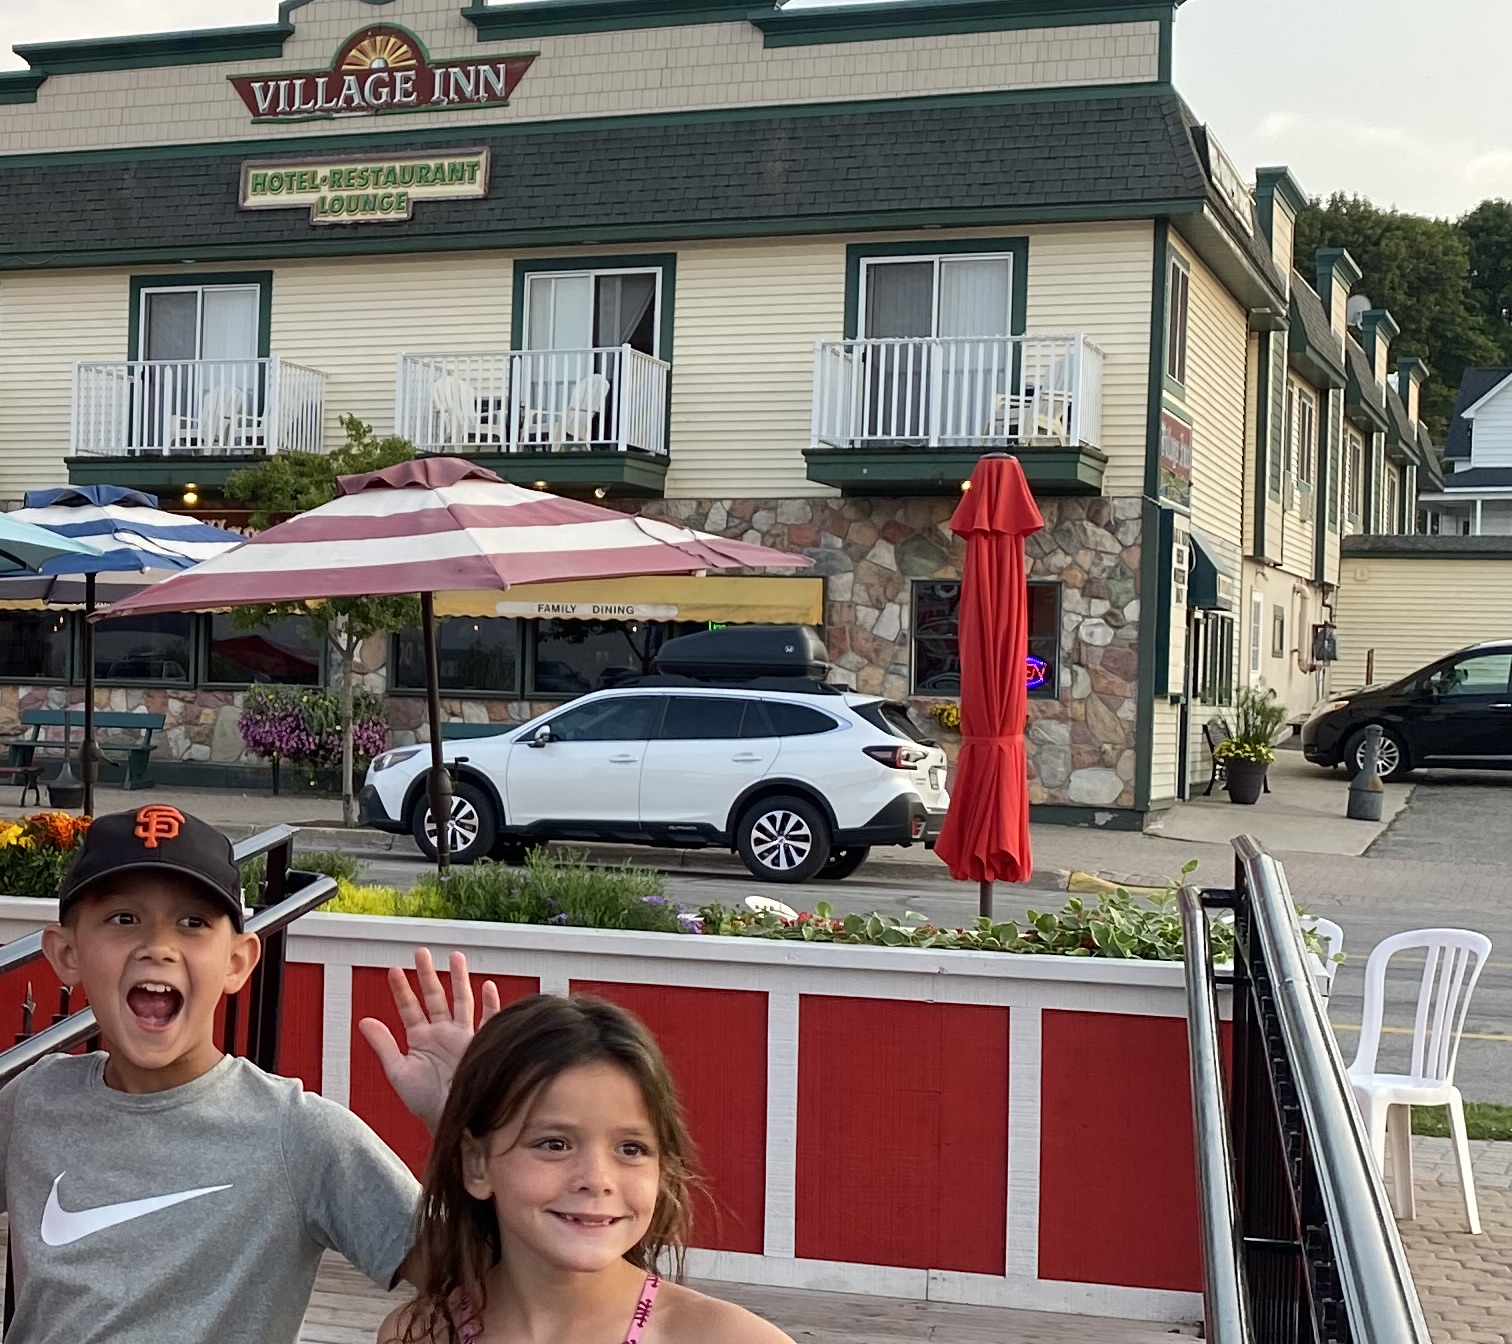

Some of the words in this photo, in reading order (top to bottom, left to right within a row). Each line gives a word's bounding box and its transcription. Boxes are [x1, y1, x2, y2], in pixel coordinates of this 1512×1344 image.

[249, 69, 418, 114] VILLAGE
[431, 63, 506, 105] INN
[318, 191, 408, 216] LOUNGE
[538, 603, 577, 613] FAMILY
[592, 605, 635, 615] DINING
[134, 804, 186, 848] SF
